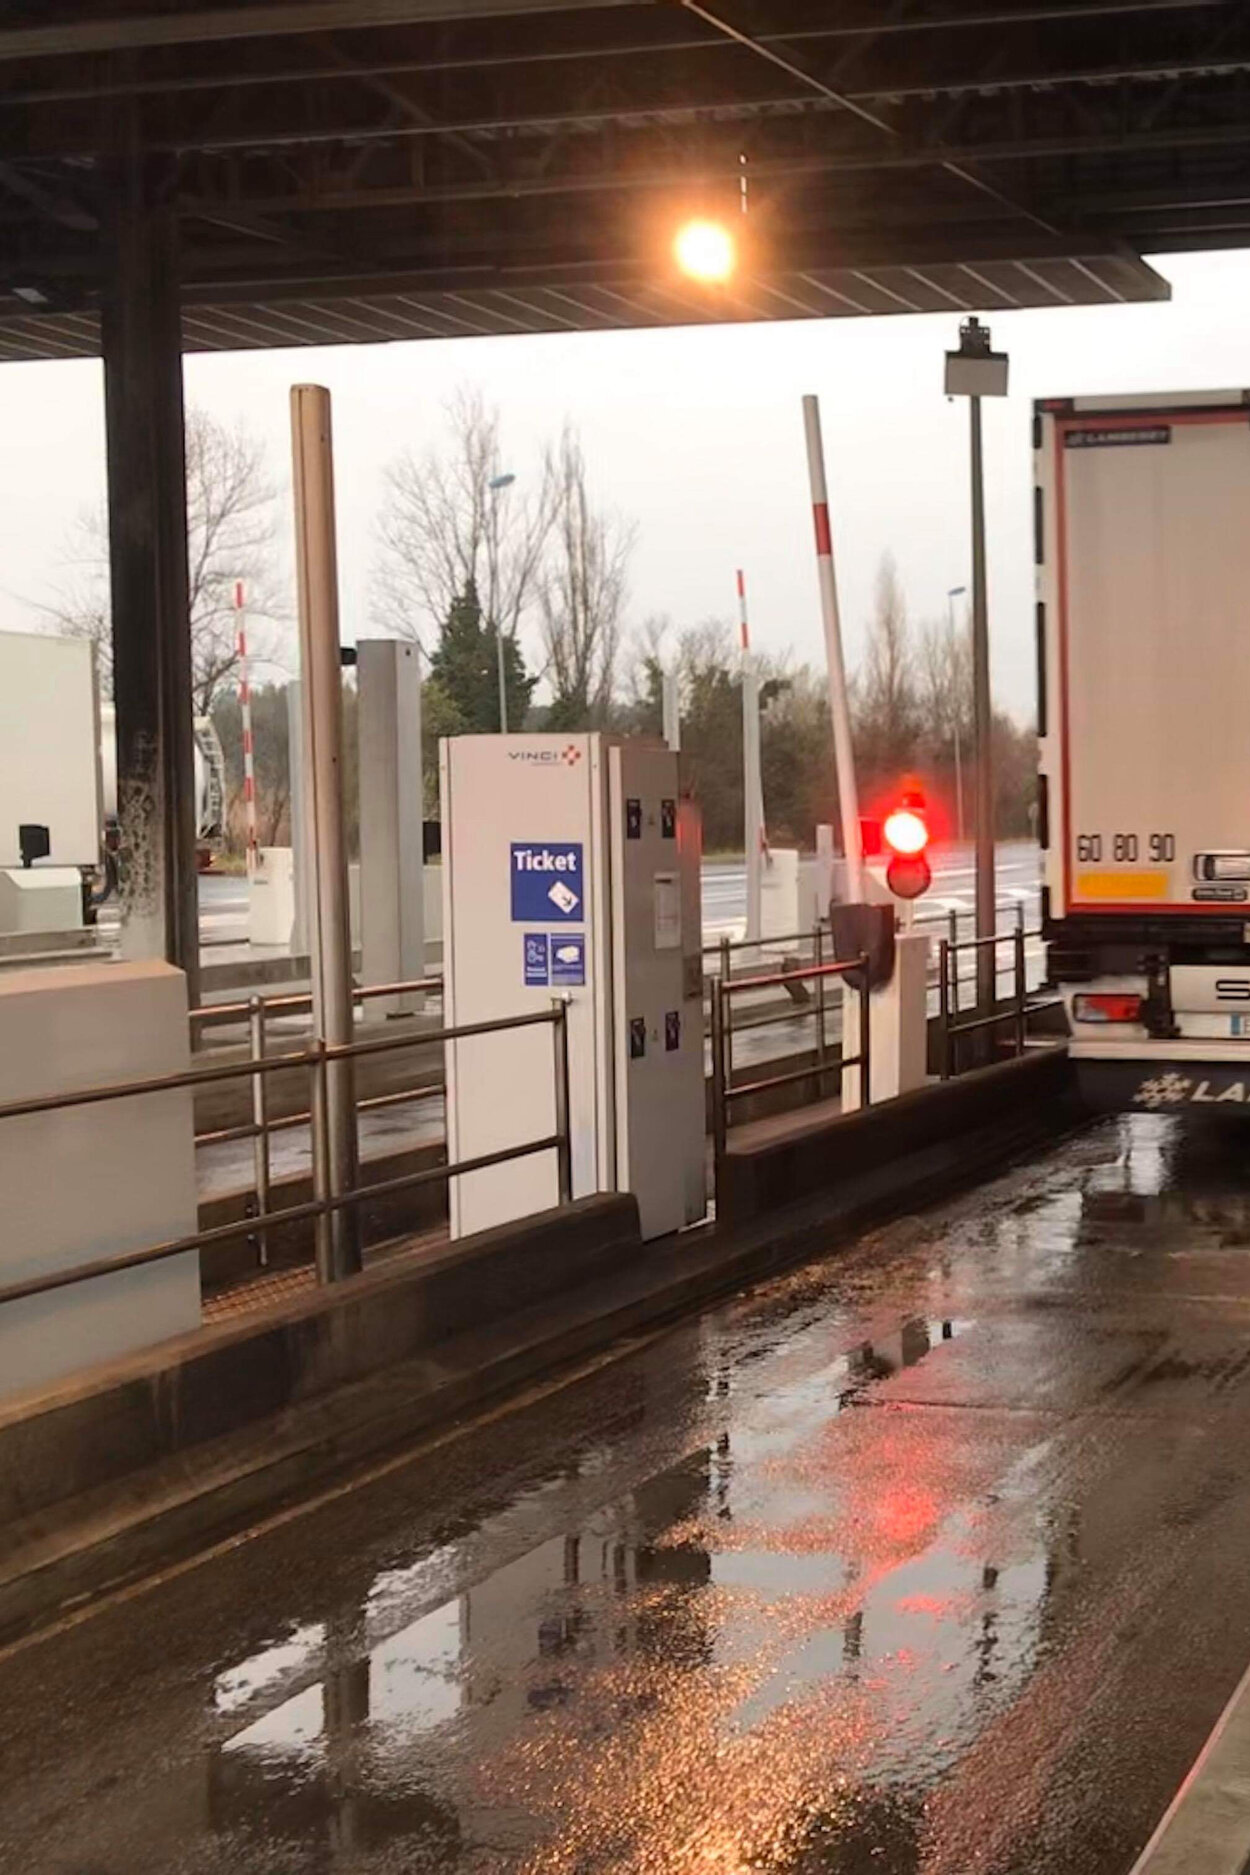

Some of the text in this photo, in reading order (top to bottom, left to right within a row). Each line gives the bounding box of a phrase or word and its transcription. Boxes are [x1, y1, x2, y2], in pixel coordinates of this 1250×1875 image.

[508, 751, 558, 760] VINCI
[1077, 834, 1175, 862] 60 80 90
[514, 849, 577, 871] Ticket
